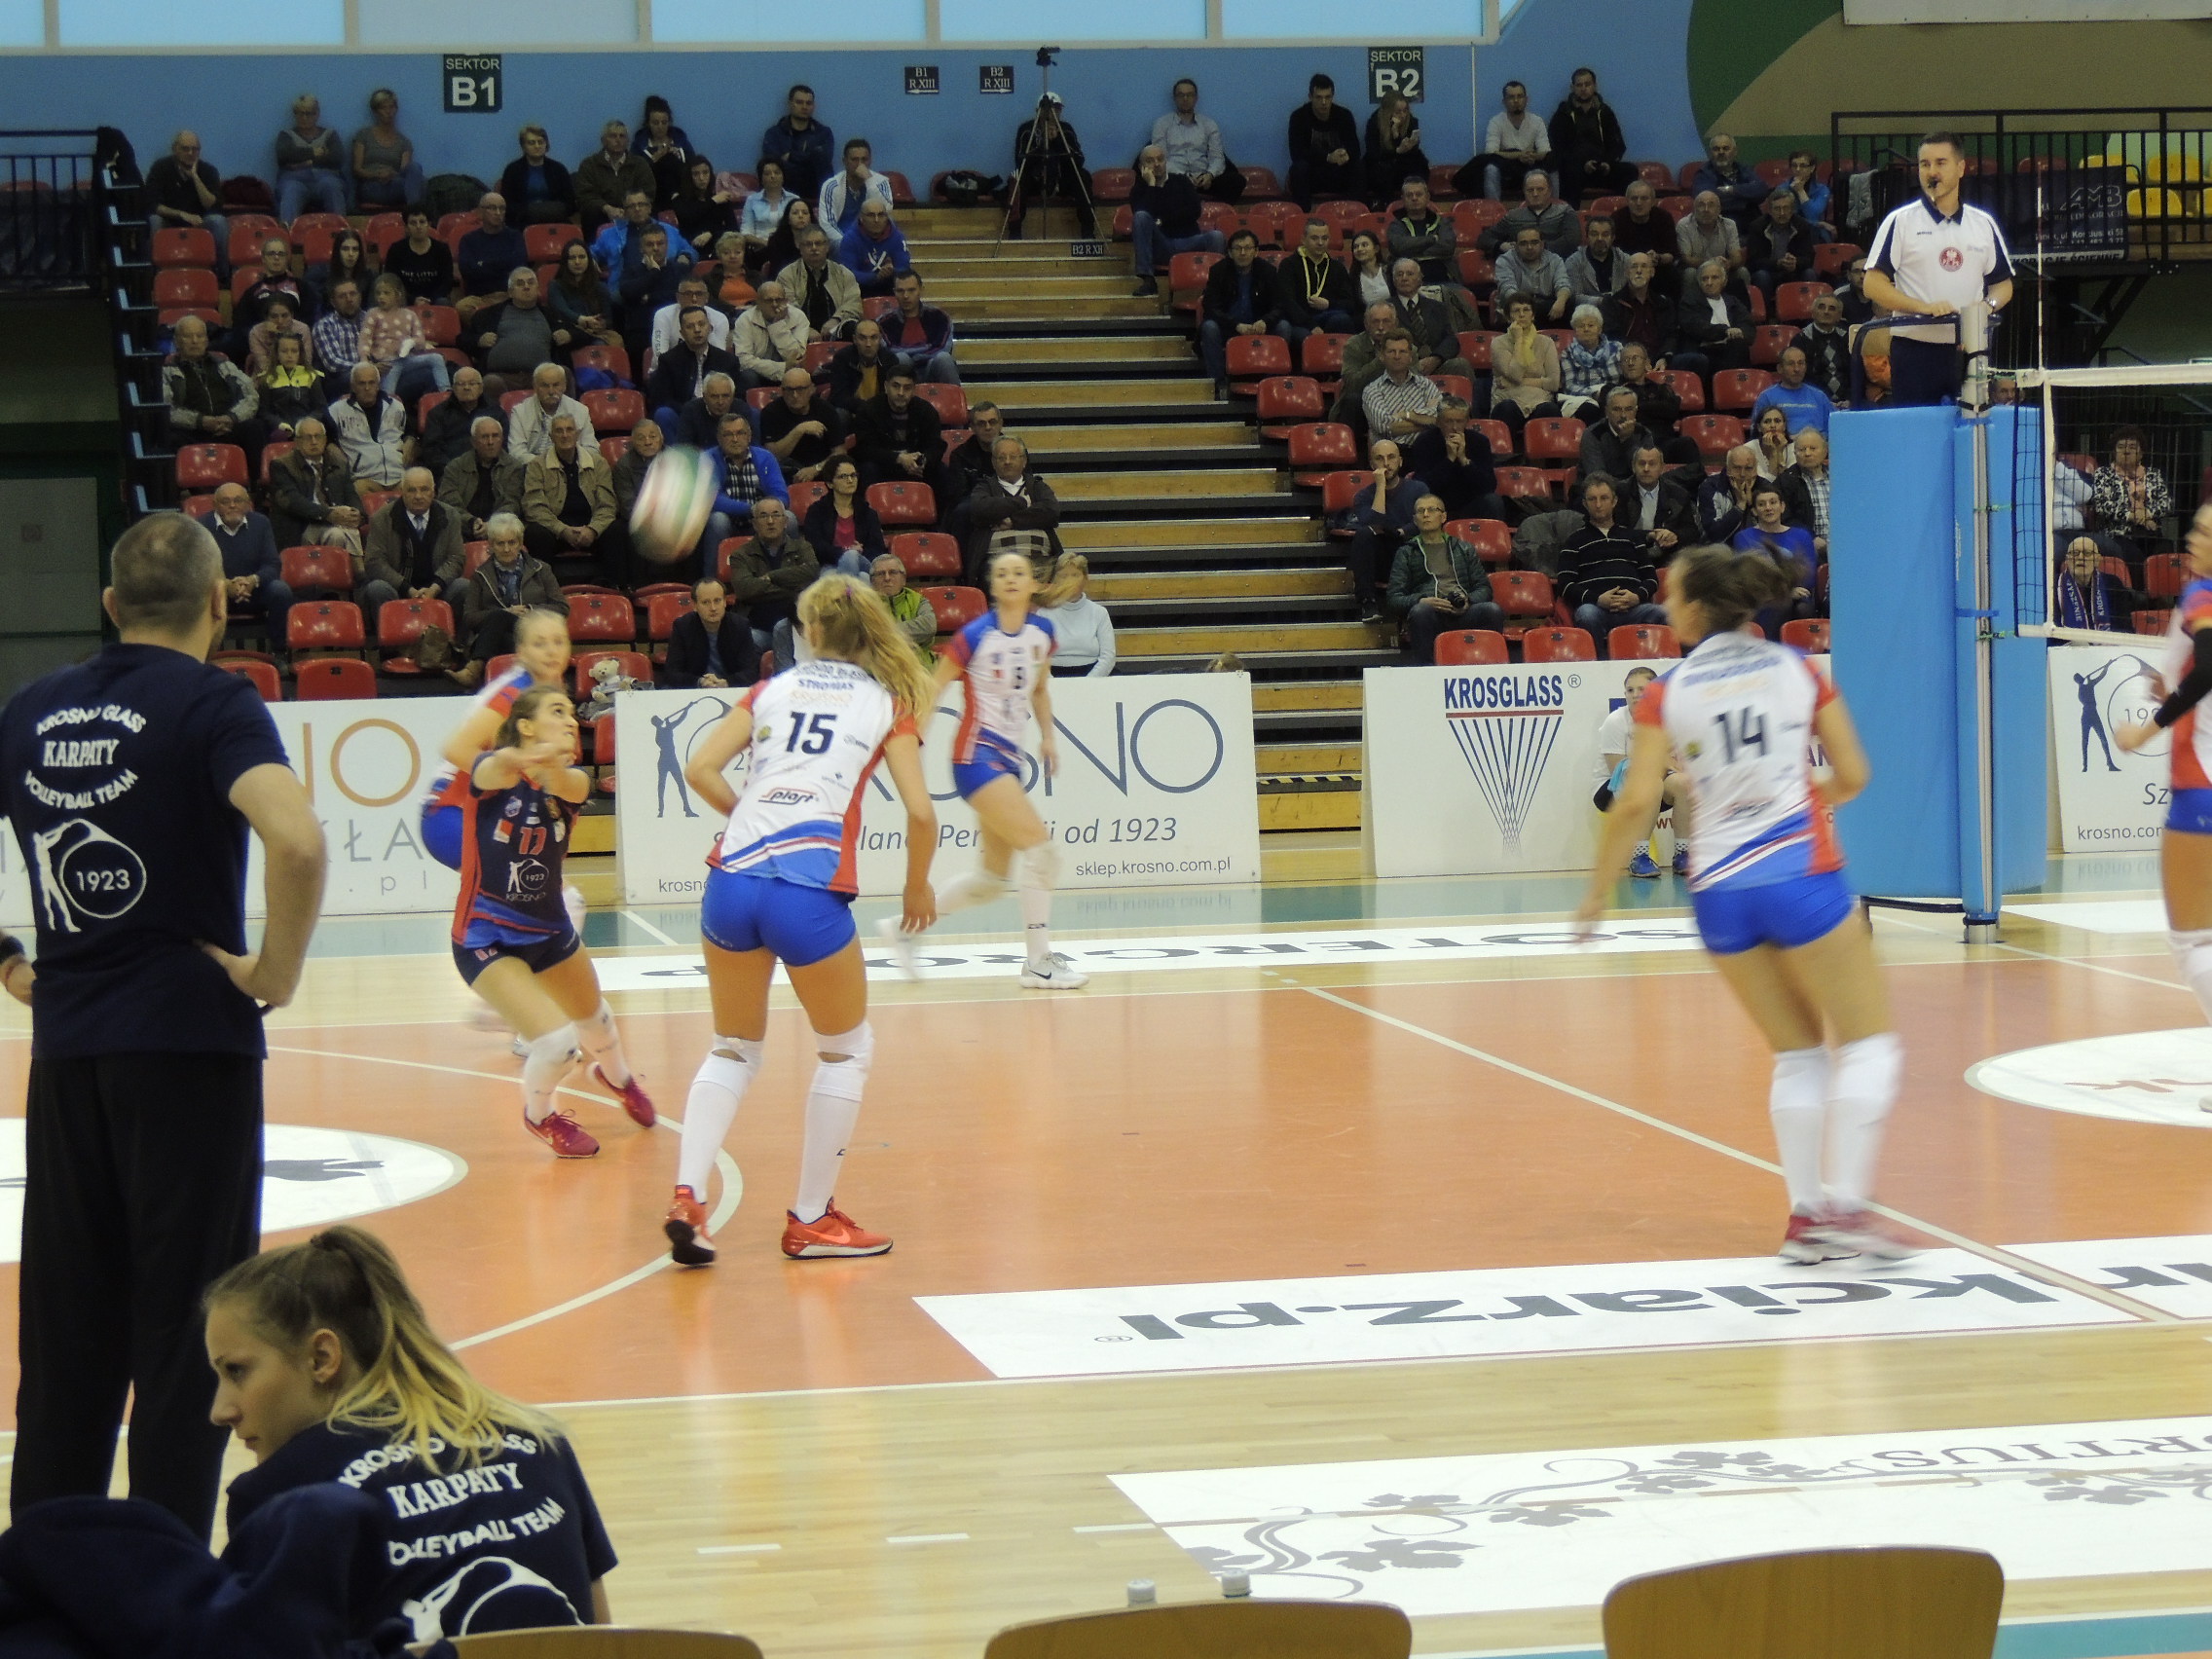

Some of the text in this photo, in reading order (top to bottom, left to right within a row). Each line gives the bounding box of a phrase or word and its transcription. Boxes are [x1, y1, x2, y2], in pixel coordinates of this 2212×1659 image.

[446, 58, 499, 70] SEKTOR
[1371, 51, 1421, 62] SEKTOR
[915, 67, 928, 78] B1
[990, 67, 1004, 77] B2
[452, 77, 495, 107] B1
[1444, 675, 1564, 710] KROSGLASS
[36, 704, 147, 735] KROSNO GLASS
[786, 711, 838, 755] 15
[1714, 705, 1770, 764] 14
[43, 739, 120, 767] KARPATY
[24, 768, 139, 809] VOLLEYBALL TEAM
[2142, 782, 2169, 805] Sz
[1064, 818, 1099, 843] od
[1109, 817, 1177, 843] 1923
[76, 868, 130, 892] 1923
[1076, 856, 1232, 878] sklep.krosno.com.pl
[1871, 1434, 2212, 1468] RTIUS
[387, 1462, 524, 1519] KARPATY
[511, 1496, 566, 1536] TEAM
